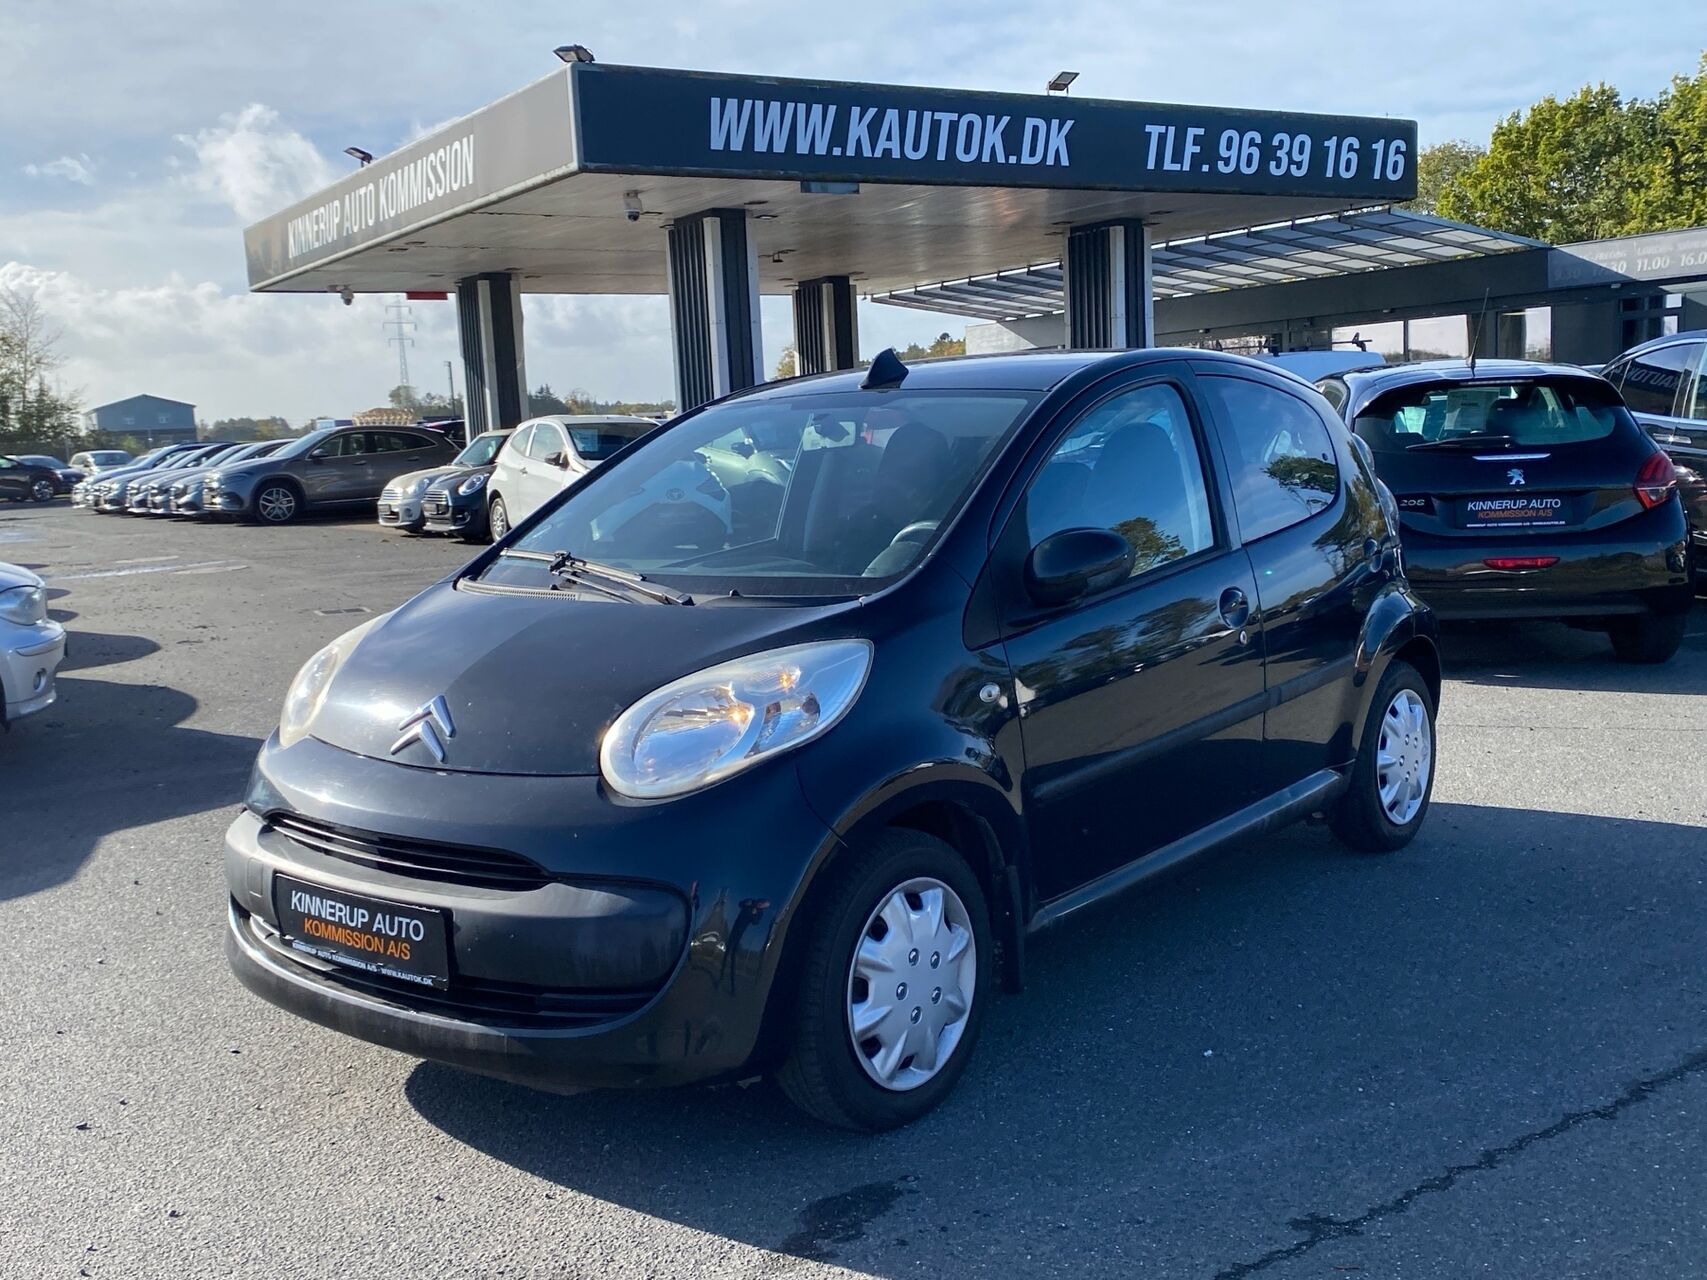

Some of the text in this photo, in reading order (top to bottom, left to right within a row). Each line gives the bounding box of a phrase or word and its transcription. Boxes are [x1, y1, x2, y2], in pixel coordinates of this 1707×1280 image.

[710, 97, 1075, 167] WWW.KAUTOK.DK
[1145, 124, 1407, 181] TLF. 96 39 16 16
[287, 134, 475, 259] KINNERUP AUTO KOMMISSION
[1636, 255, 1670, 272] 11.00
[1680, 250, 1707, 267] 16.0
[1467, 498, 1562, 511] KINNERUP AUTO
[1477, 508, 1554, 519] KOMMISSION A/S
[291, 890, 424, 942] KINNERUP AUTO
[303, 917, 411, 961] KOMMISSION A/S
